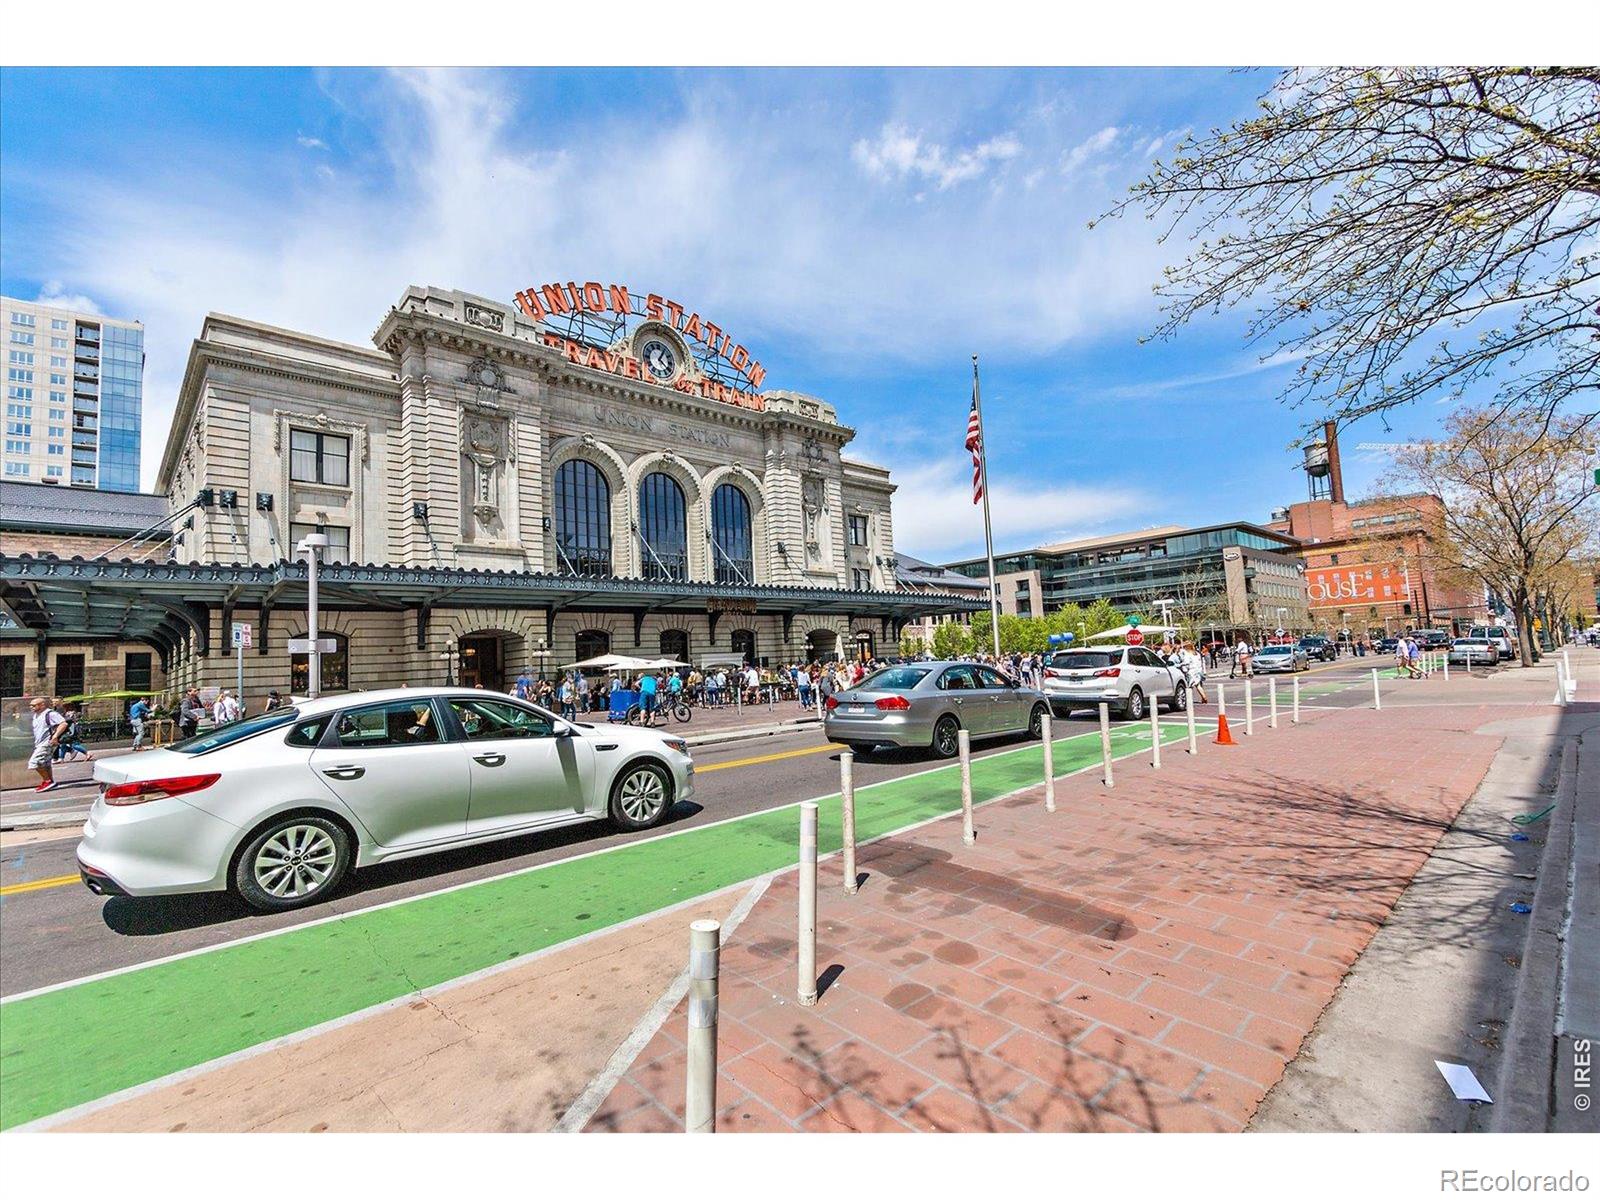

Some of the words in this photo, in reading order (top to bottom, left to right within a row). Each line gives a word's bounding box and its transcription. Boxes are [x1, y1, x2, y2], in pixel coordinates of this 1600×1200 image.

[515, 281, 631, 321] UNION
[646, 293, 767, 388] STATION
[700, 376, 764, 411] TRAIN
[593, 406, 655, 432] UNION
[667, 422, 730, 448] STATION
[1126, 633, 1143, 642] STOP
